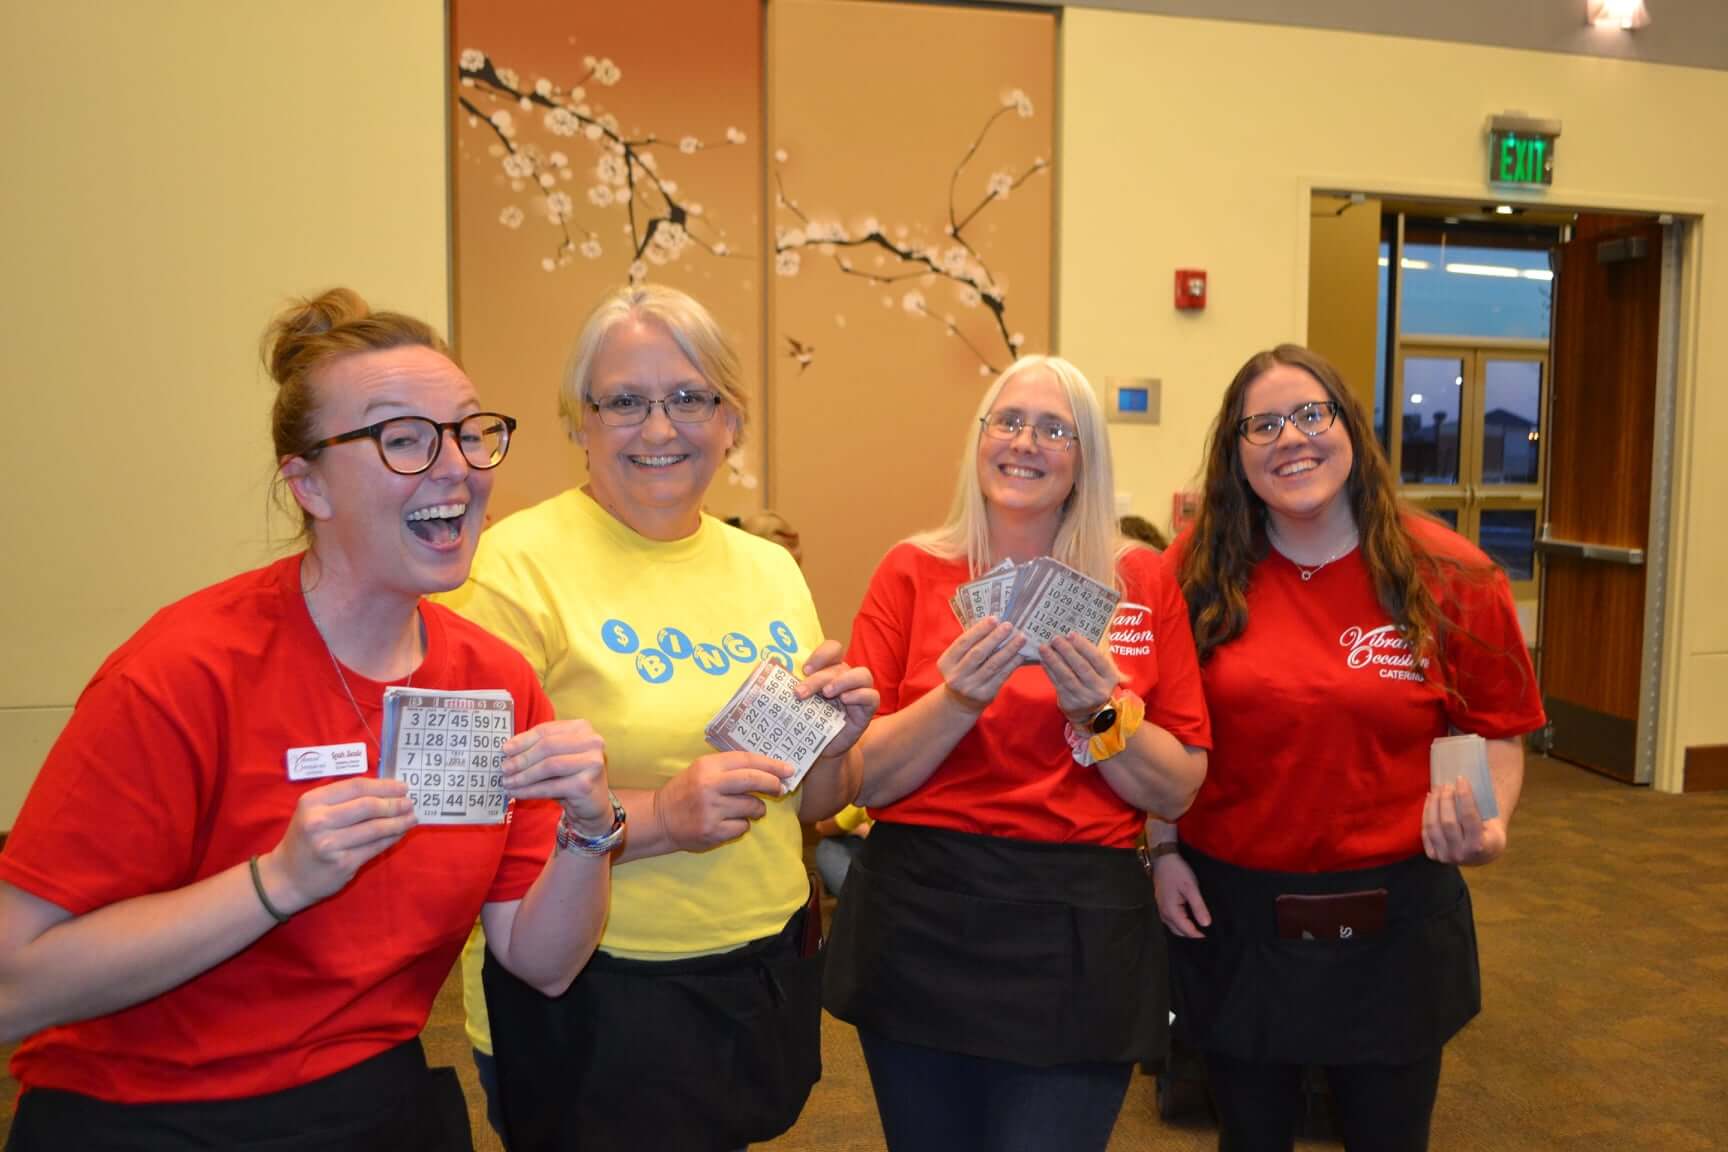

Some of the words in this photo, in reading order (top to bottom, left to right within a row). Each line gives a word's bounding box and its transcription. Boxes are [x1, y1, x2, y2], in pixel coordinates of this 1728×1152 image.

[1502, 138, 1545, 183] EXIT
[1110, 645, 1150, 656] ATERING
[1339, 626, 1409, 651] Vibra
[411, 713, 420, 726] 3
[428, 714, 446, 727] 27
[451, 715, 469, 728] 45
[474, 716, 490, 728] 59
[494, 717, 507, 729] 71
[738, 725, 747, 736] 2
[746, 708, 759, 723] 22
[757, 694, 770, 708] 43
[767, 681, 779, 694] 56
[747, 732, 761, 747] 12
[757, 717, 770, 733] 27
[769, 703, 782, 718] 38
[779, 690, 791, 704] 55
[405, 733, 420, 746] 11
[426, 734, 444, 746] 28
[450, 734, 467, 747] 34
[473, 735, 489, 748] 50
[759, 741, 772, 755] 10
[769, 727, 783, 742] 20
[782, 737, 794, 751] 17
[793, 722, 806, 737] 42
[803, 707, 816, 721] 49
[793, 746, 807, 761] 25
[805, 731, 817, 746] 37
[815, 717, 827, 731] 54
[407, 752, 415, 765] 7
[425, 753, 442, 766] 19
[472, 755, 488, 768] 48
[424, 773, 441, 786] 29
[447, 774, 465, 786] 32
[470, 775, 486, 787] 51
[423, 793, 440, 807] 25
[446, 794, 463, 807] 44
[469, 795, 485, 807] 54
[487, 794, 502, 806] 72
